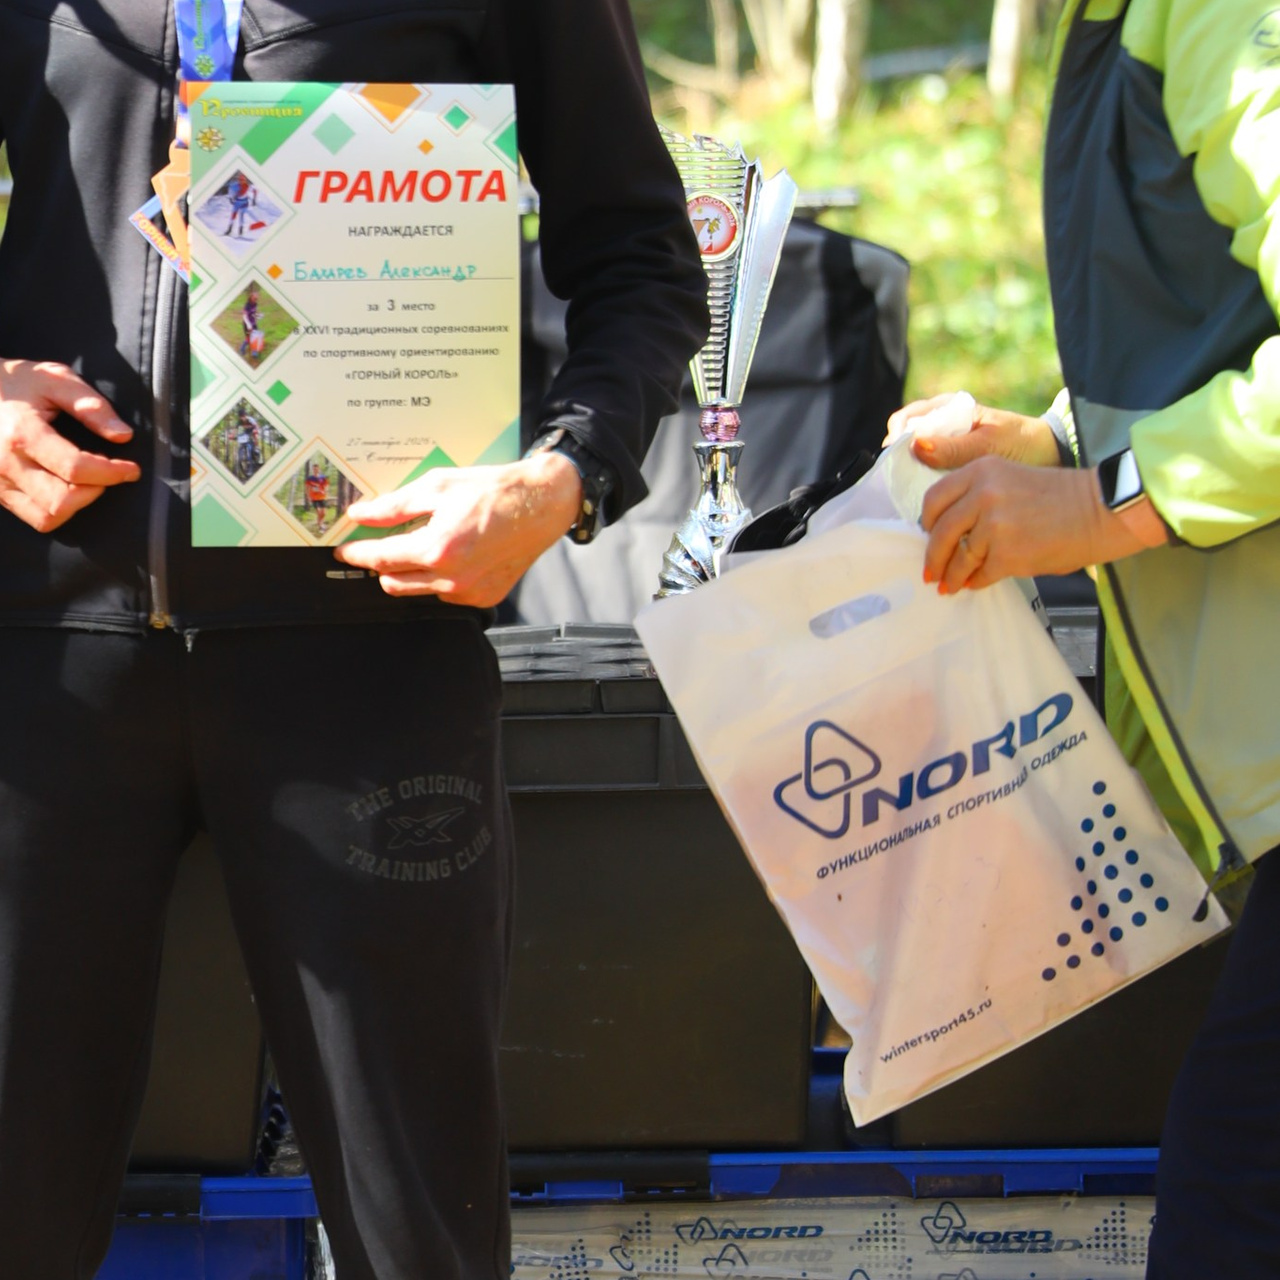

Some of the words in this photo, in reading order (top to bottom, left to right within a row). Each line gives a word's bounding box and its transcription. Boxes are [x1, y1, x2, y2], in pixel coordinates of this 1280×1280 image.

[293, 169, 508, 204] ГРАМОТА
[348, 225, 454, 238] НАГРАЖДАЕТСЯ
[367, 303, 379, 312] за
[387, 299, 396, 312] 3
[401, 302, 436, 312] место
[302, 325, 330, 335] XXVI
[332, 325, 418, 337] традиционных
[421, 324, 509, 335] соревнованиях
[303, 349, 317, 358] по
[320, 348, 396, 360] спортивному
[399, 347, 500, 359] ориентированию
[345, 367, 401, 380] «ГОРНЫЙ
[404, 369, 458, 379] КОРОЛЬ»
[347, 398, 361, 407] по
[410, 396, 432, 407] МЭ
[862, 692, 1074, 828] NORD
[345, 786, 394, 822] THE
[398, 774, 483, 805] ORIGINAL
[816, 814, 942, 880] ФУНКЦИОНАЛЬНАЯ
[1030, 730, 1088, 771] ОДЕЖДА
[345, 844, 452, 883] TRAINING
[454, 825, 493, 871] CLUB
[880, 997, 993, 1063] wintersport45.ru
[720, 1224, 824, 1239] NORD
[949, 1229, 1053, 1244] NORD
